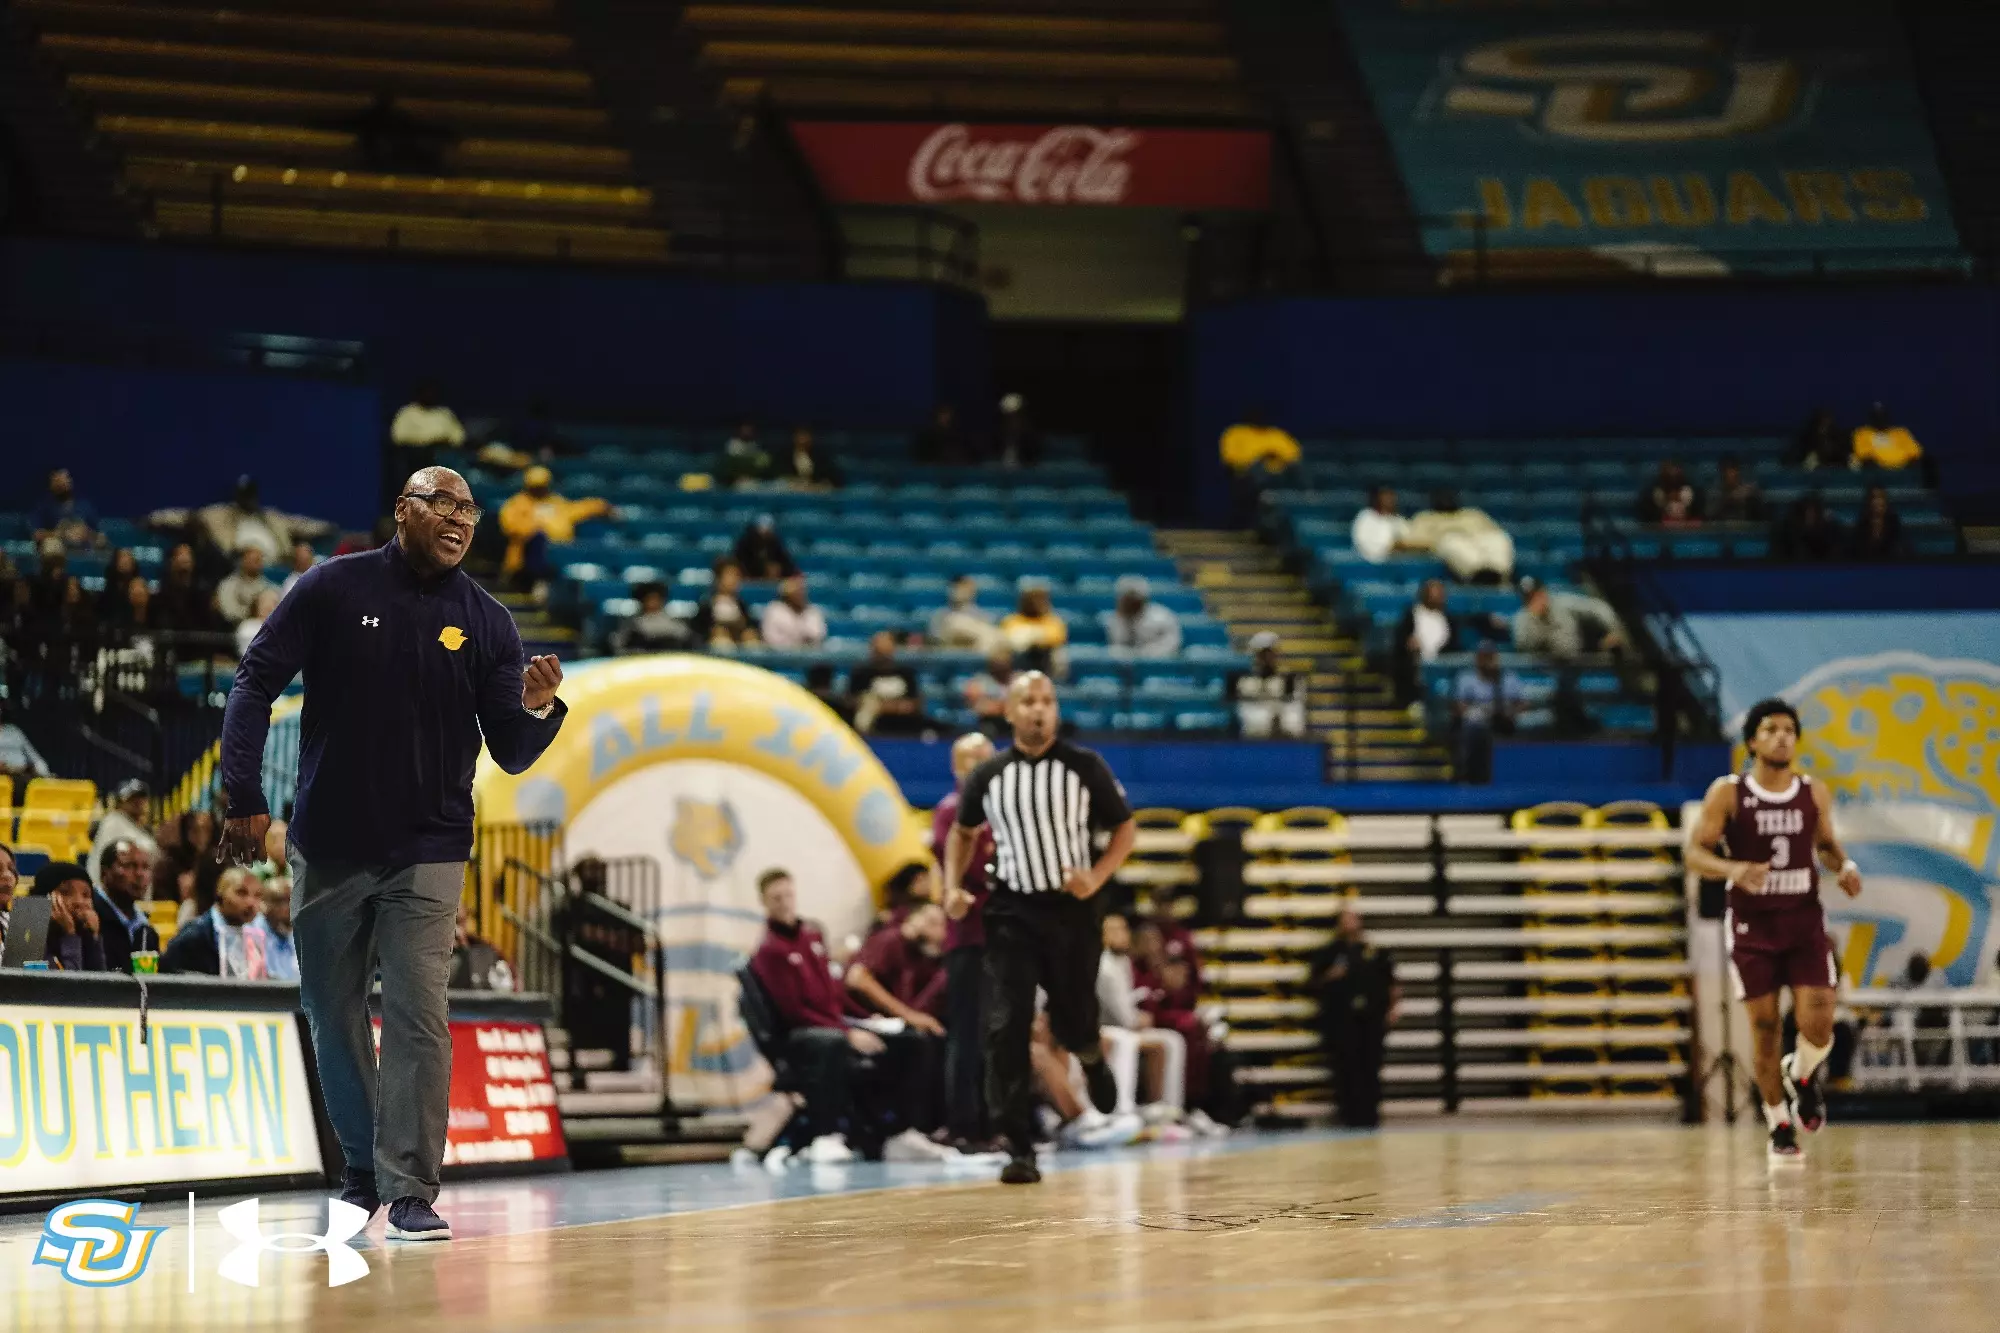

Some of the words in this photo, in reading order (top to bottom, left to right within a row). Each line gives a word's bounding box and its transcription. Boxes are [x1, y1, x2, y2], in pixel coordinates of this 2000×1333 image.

[1449, 168, 1929, 231] JAGUARS
[588, 692, 728, 781] ALL
[753, 705, 863, 790] IN
[1755, 808, 1804, 835] TEXAS
[1770, 835, 1791, 869] 3
